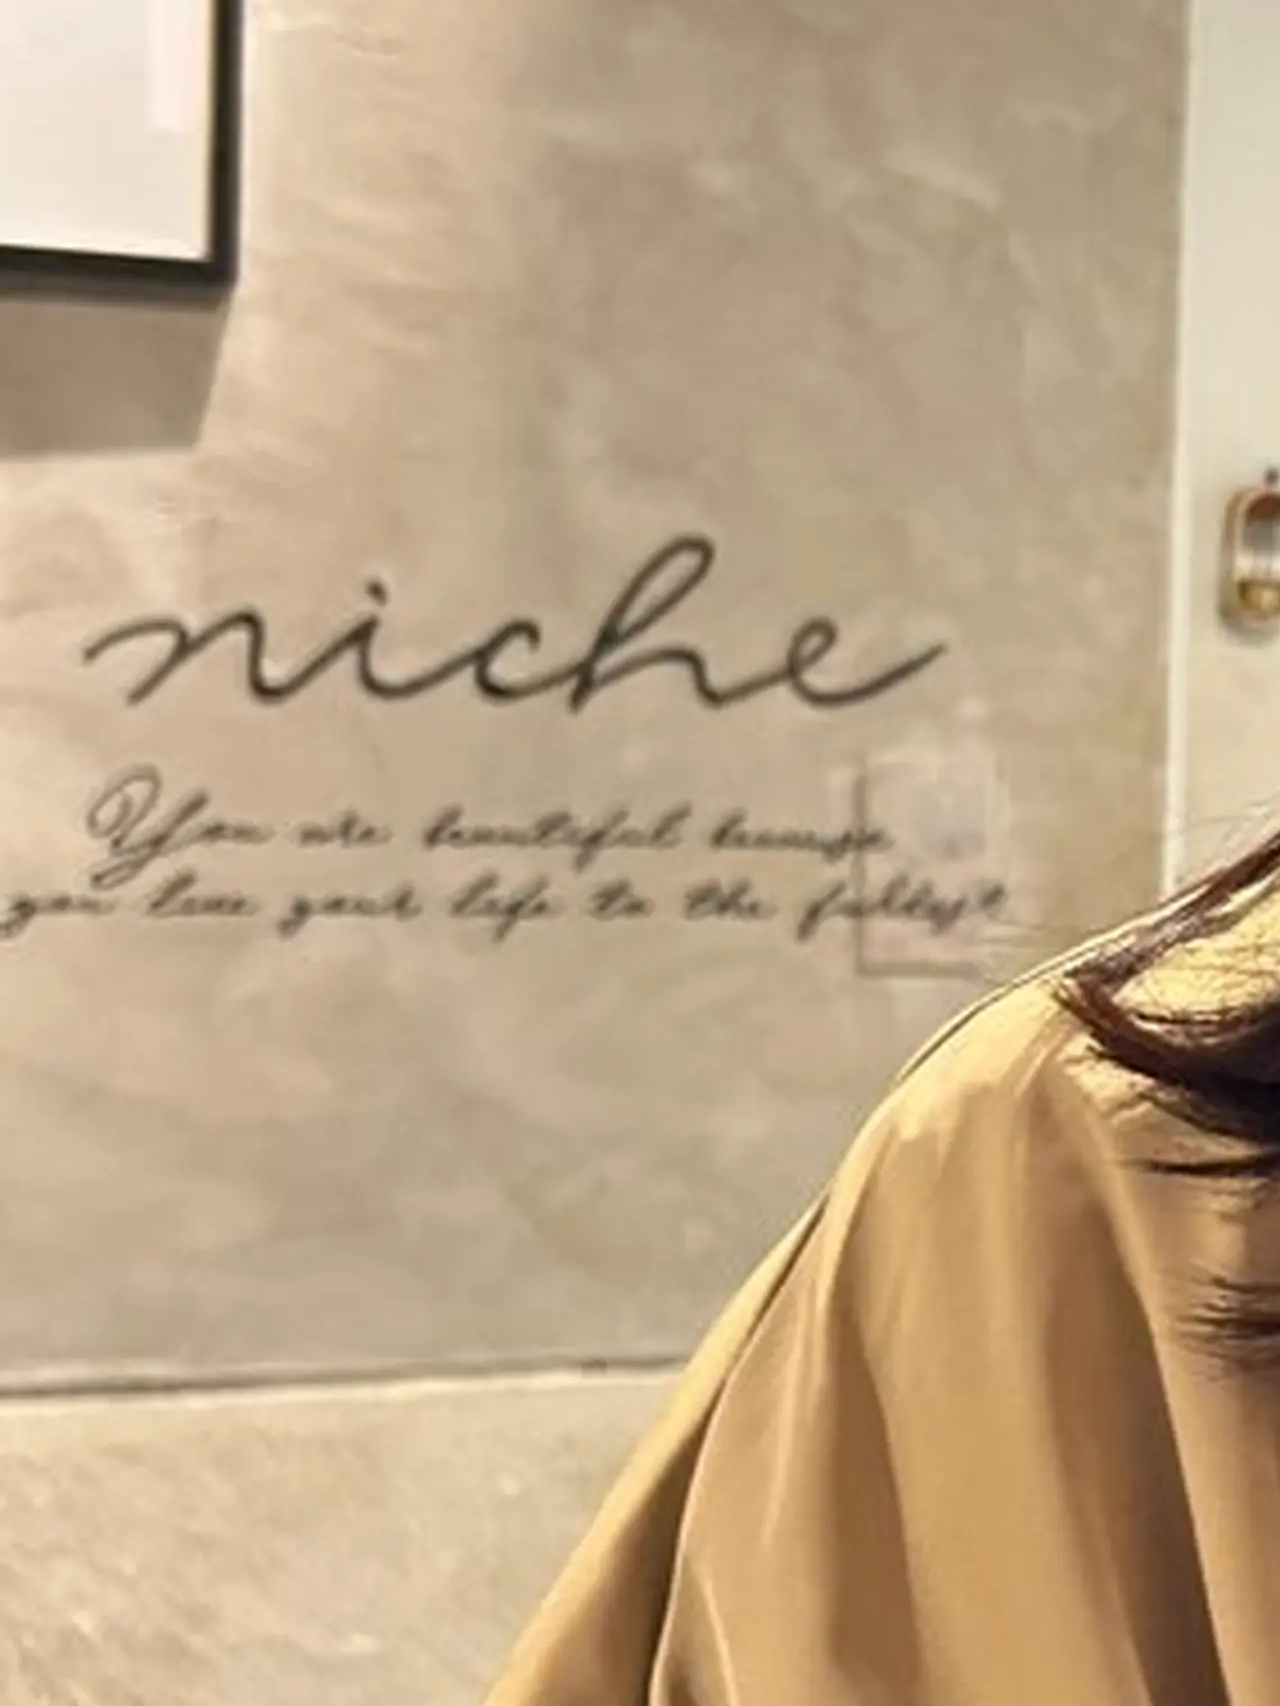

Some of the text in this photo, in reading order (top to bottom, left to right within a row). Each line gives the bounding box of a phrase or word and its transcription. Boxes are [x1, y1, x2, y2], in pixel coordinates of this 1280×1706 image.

[83, 533, 946, 713] niche
[86, 764, 276, 890] You
[423, 800, 692, 872] beautiful
[447, 873, 565, 943] life
[588, 878, 655, 920] to
[682, 878, 778, 922] the
